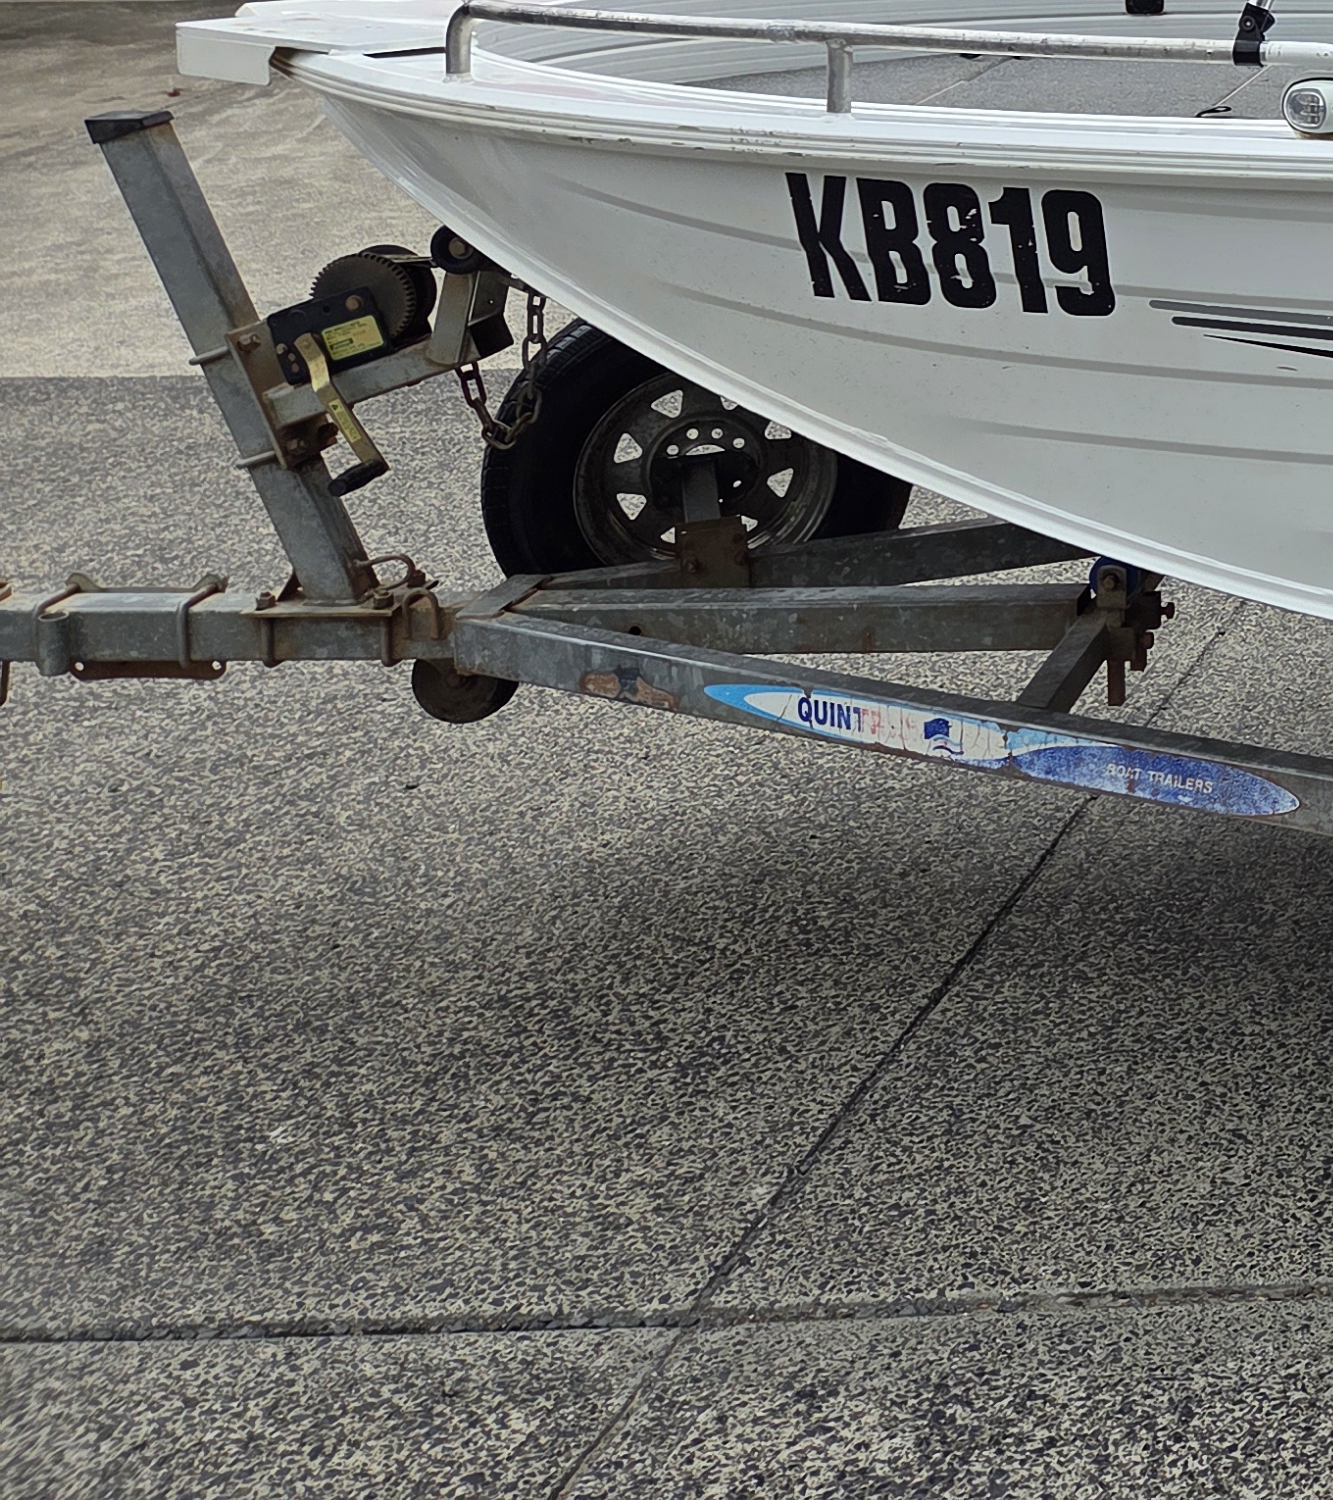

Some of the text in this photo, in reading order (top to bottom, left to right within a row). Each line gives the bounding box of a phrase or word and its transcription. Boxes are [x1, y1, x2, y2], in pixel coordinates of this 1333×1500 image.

[785, 171, 1116, 317] KB819
[1105, 763, 1214, 794] BOAT TRAILERS
